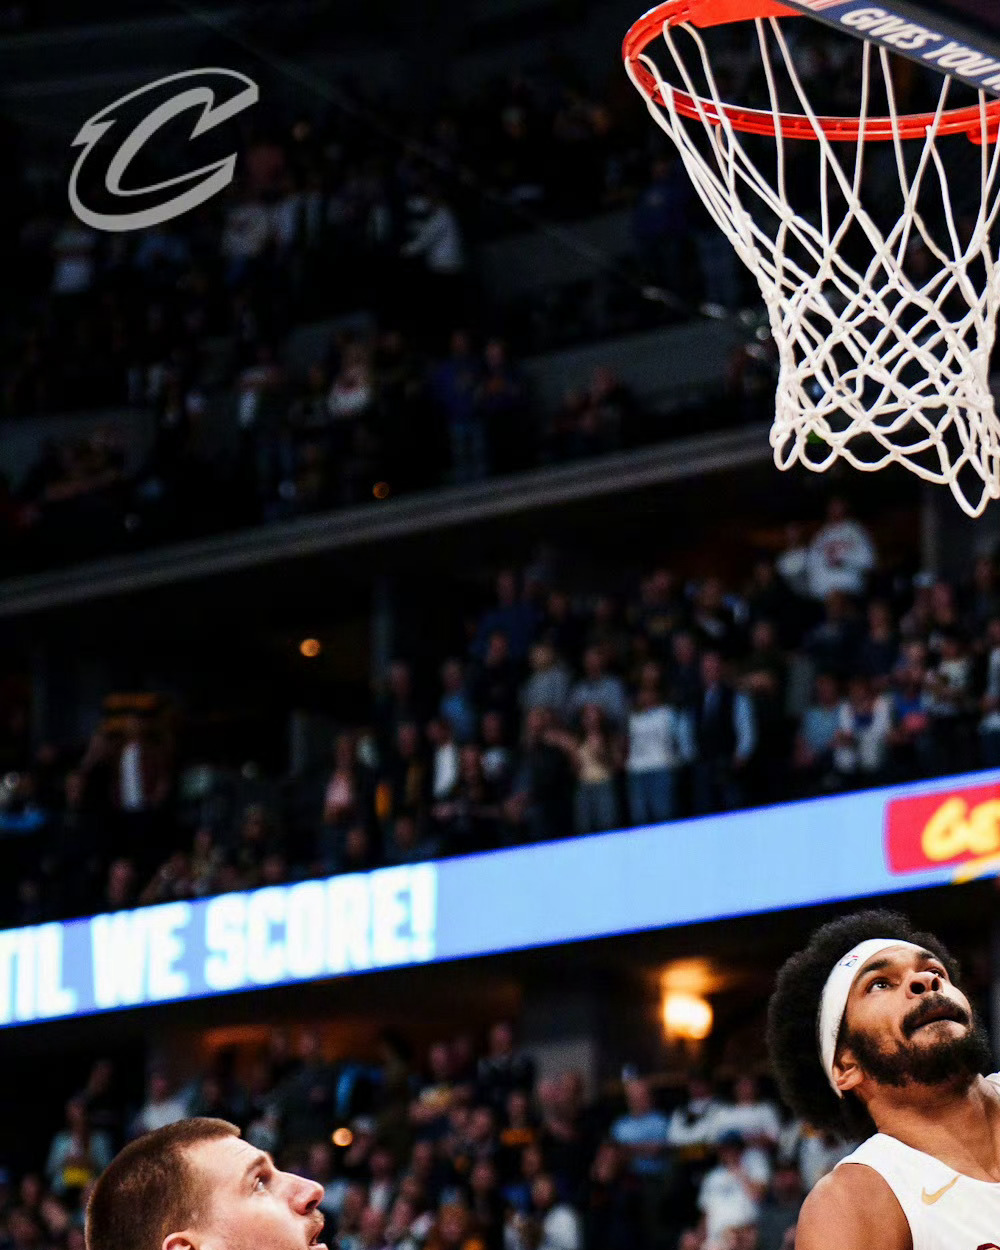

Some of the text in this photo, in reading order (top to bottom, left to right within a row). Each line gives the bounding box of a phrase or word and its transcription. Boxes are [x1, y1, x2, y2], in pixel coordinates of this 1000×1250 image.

[840, 7, 944, 50] GIVES
[91, 900, 193, 1010] WE
[204, 862, 438, 991] SCORE!
